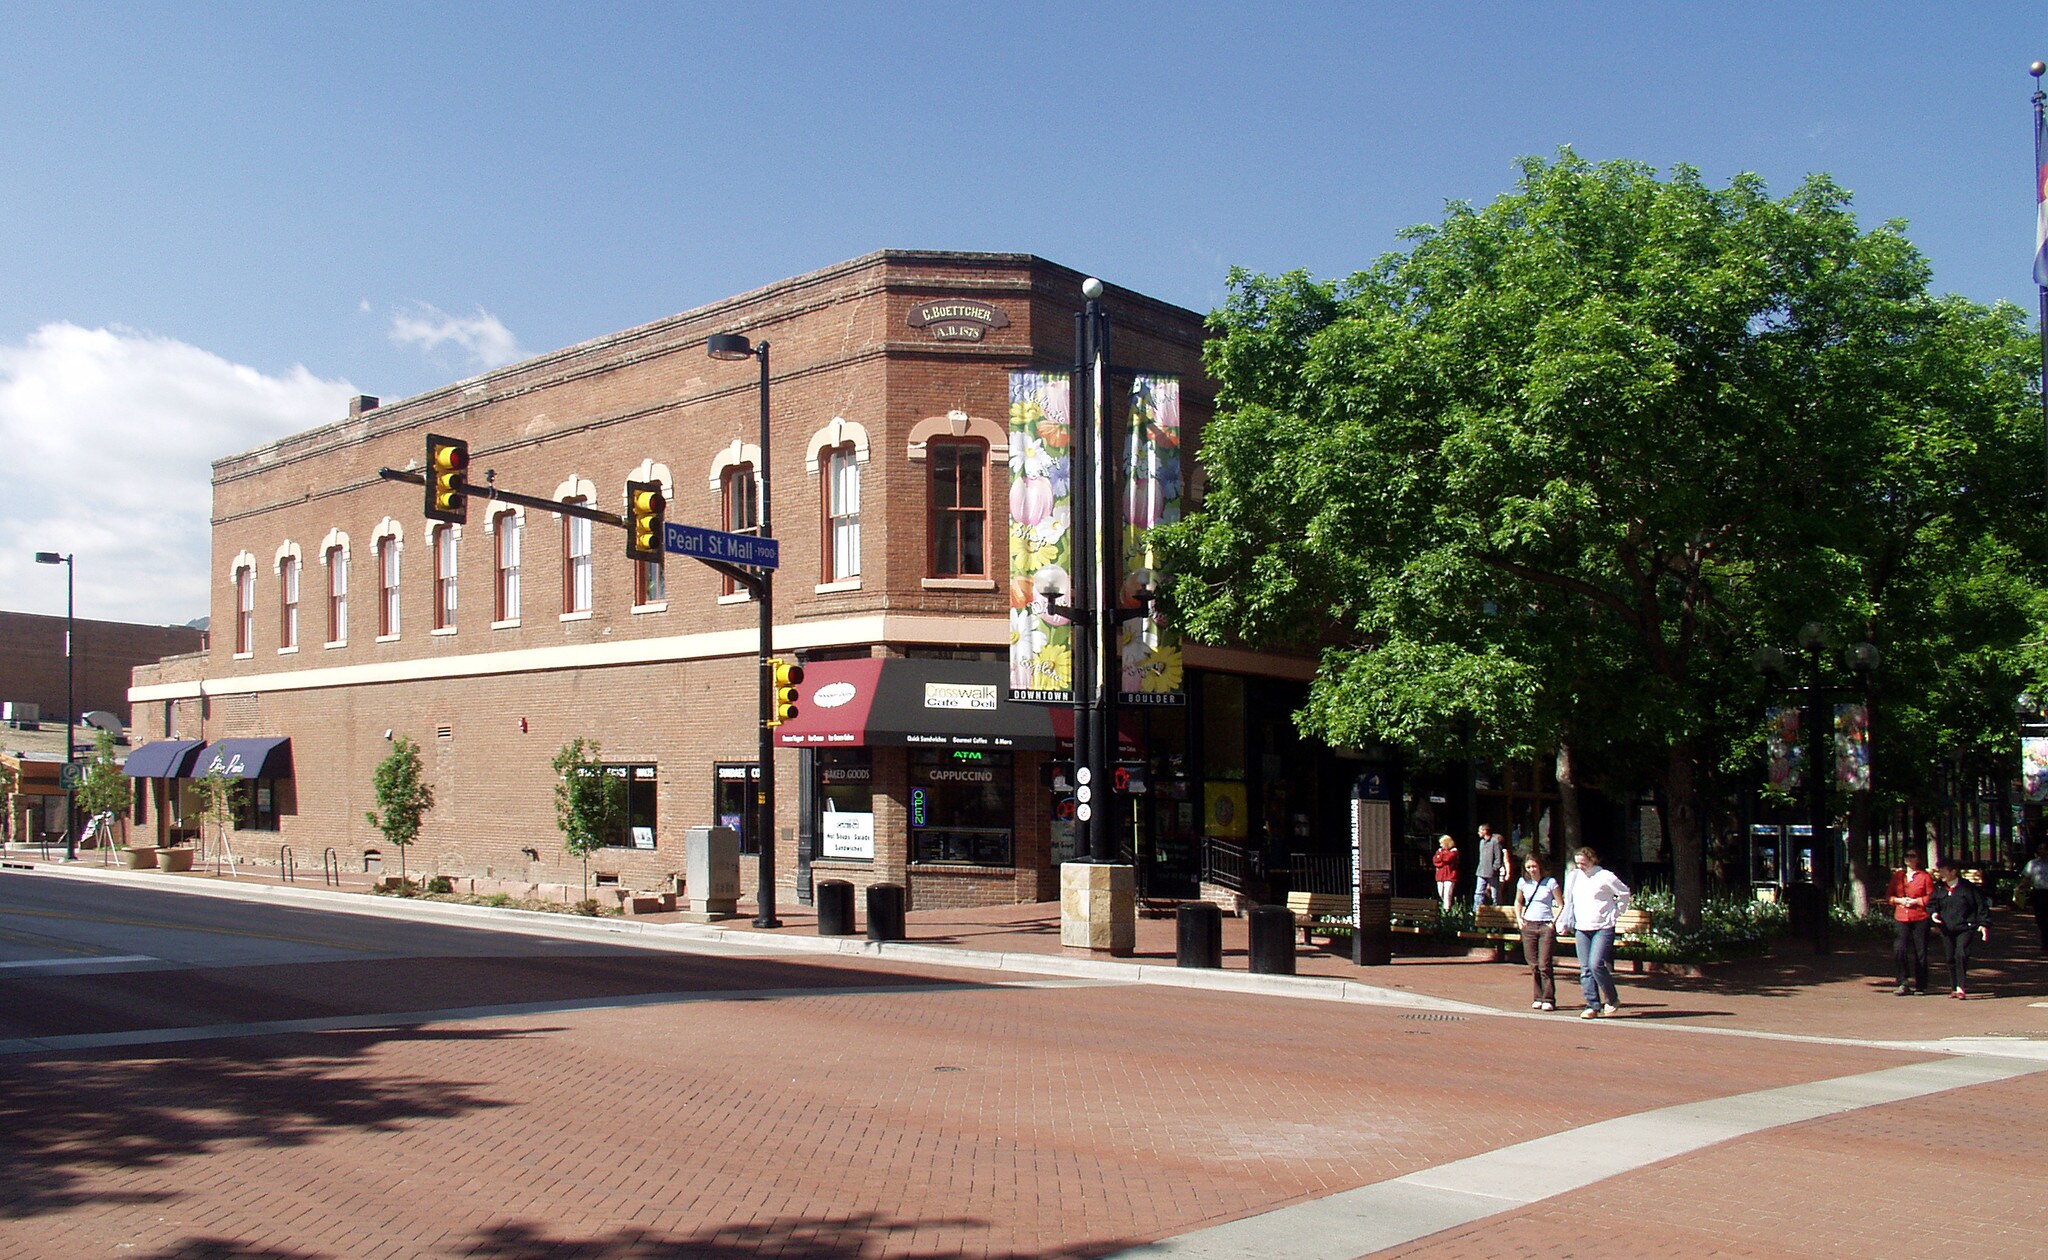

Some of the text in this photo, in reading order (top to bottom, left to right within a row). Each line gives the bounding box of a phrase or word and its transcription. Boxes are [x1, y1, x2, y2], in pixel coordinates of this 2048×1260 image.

[960, 326, 980, 338] 1878
[668, 528, 703, 553] Pearl
[727, 538, 753, 560] Mall
[927, 685, 995, 699] Crosswalk
[1014, 690, 1068, 701] DOWNTOWN
[970, 699, 996, 709] Deli
[1128, 693, 1176, 704] BOULDER
[920, 735, 947, 744] Sandwiches
[953, 750, 982, 760] ATM
[847, 768, 871, 779] GOODS
[929, 770, 993, 782] CAPPUCCINO
[913, 790, 924, 824] OPEN
[1351, 799, 1359, 847] DOWNTOWN
[835, 844, 863, 852] Sandwiches
[1352, 848, 1360, 885] BOULDER
